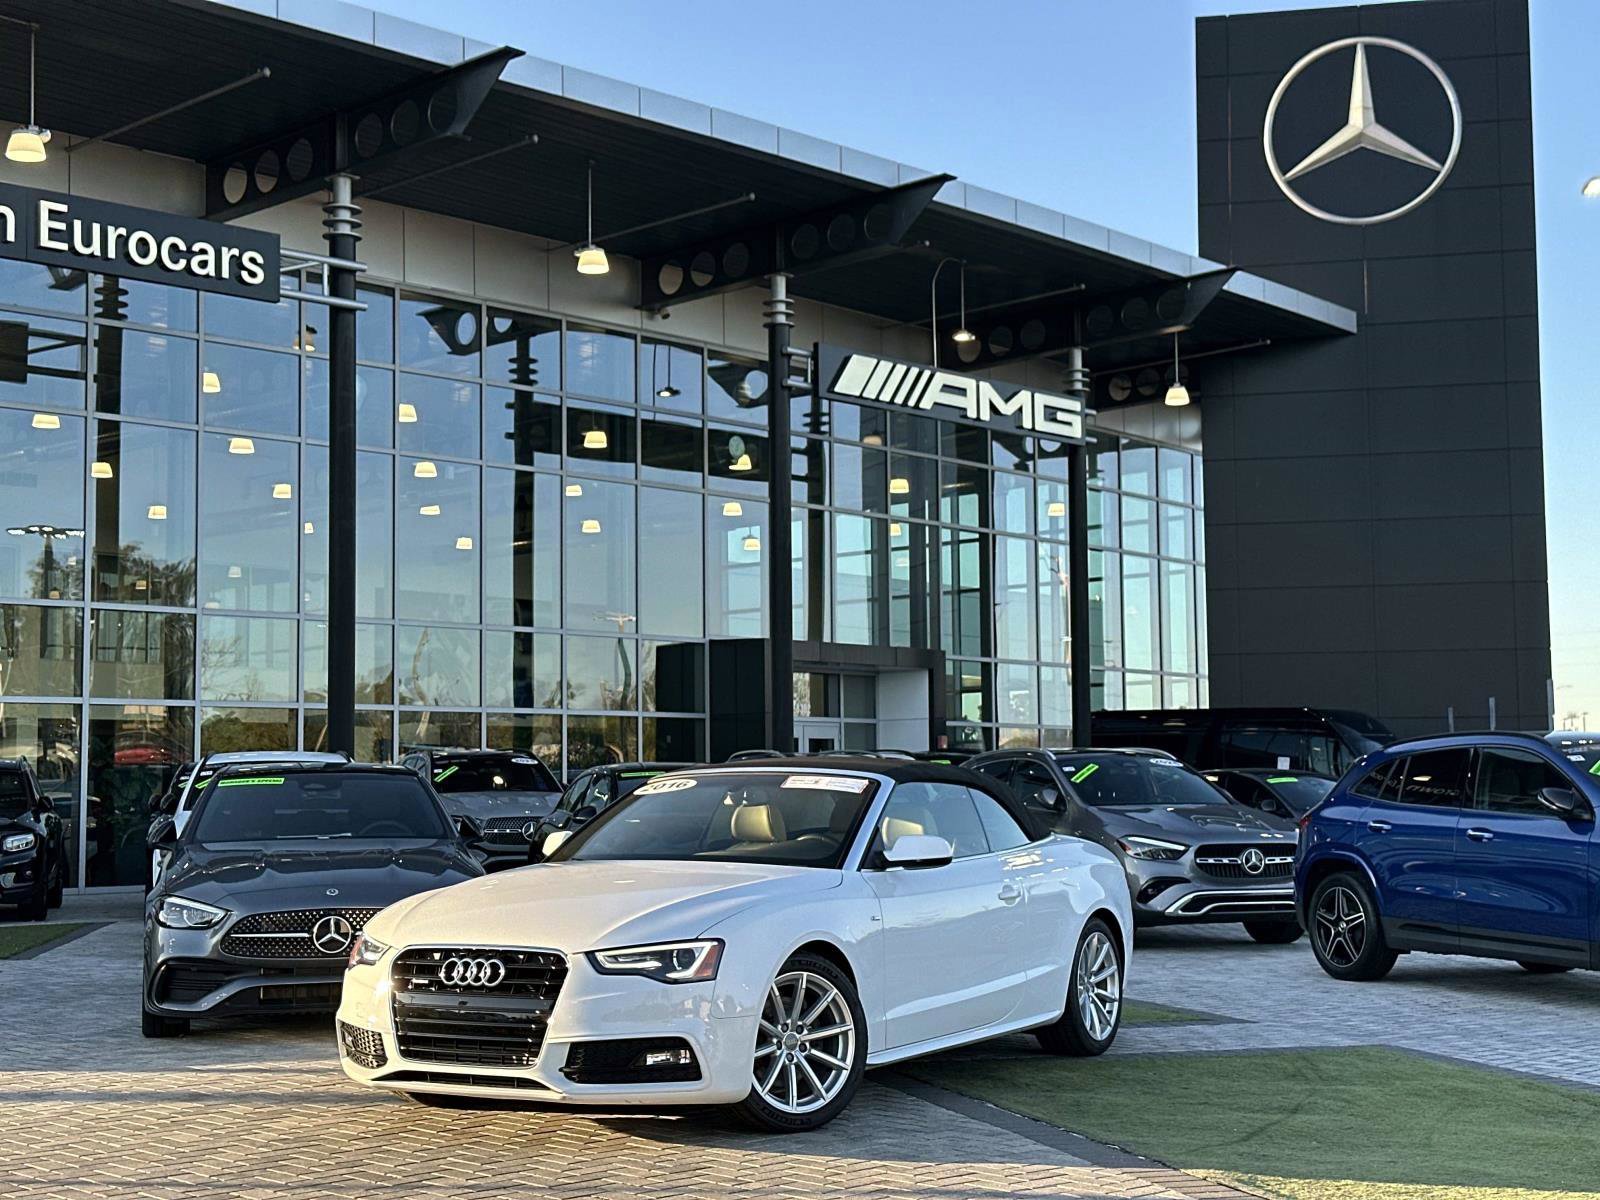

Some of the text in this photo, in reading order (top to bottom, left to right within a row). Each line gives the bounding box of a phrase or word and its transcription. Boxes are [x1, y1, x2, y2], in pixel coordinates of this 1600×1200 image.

[38, 198, 266, 286] Eurocars
[919, 371, 1083, 439] AMG
[639, 780, 691, 793] 2016
